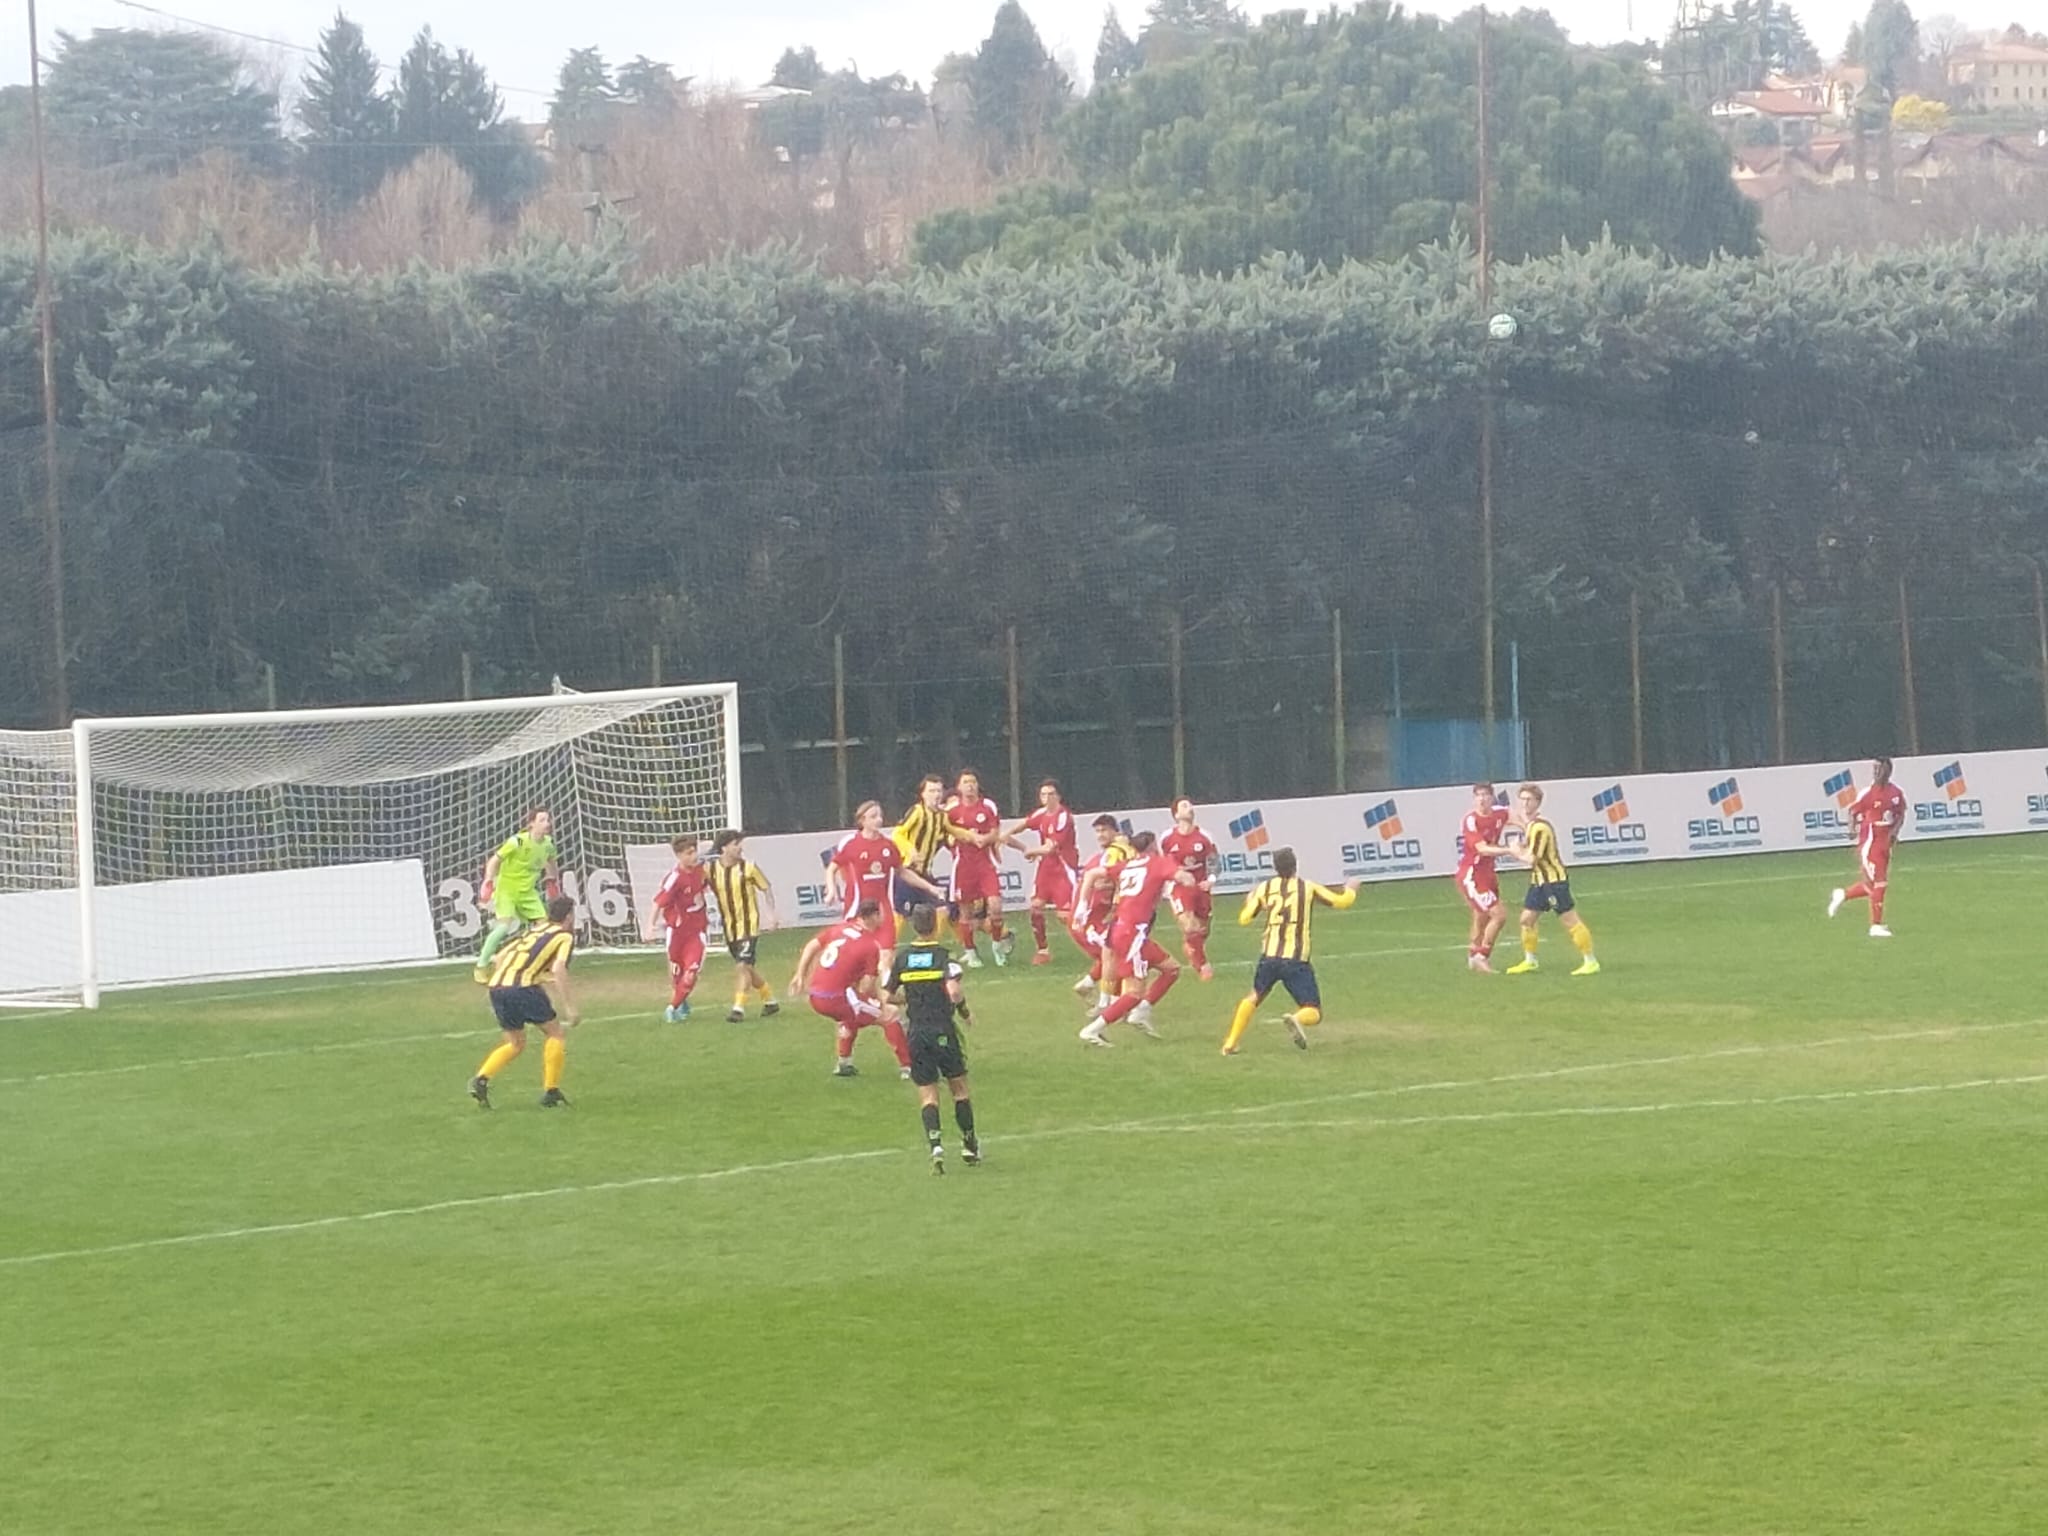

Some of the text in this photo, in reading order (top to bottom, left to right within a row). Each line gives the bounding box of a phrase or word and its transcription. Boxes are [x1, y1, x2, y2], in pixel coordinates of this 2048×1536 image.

[1803, 810, 1848, 829] SIEL
[1914, 800, 1983, 820] SIELCO
[1572, 823, 1646, 845] SIELCO
[1688, 816, 1760, 838] SIELCO
[1222, 851, 1273, 872] IELC
[1342, 839, 1421, 862] SIELCO
[1267, 892, 1297, 924] 21
[740, 941, 752, 957] 2
[820, 938, 847, 968] 6
